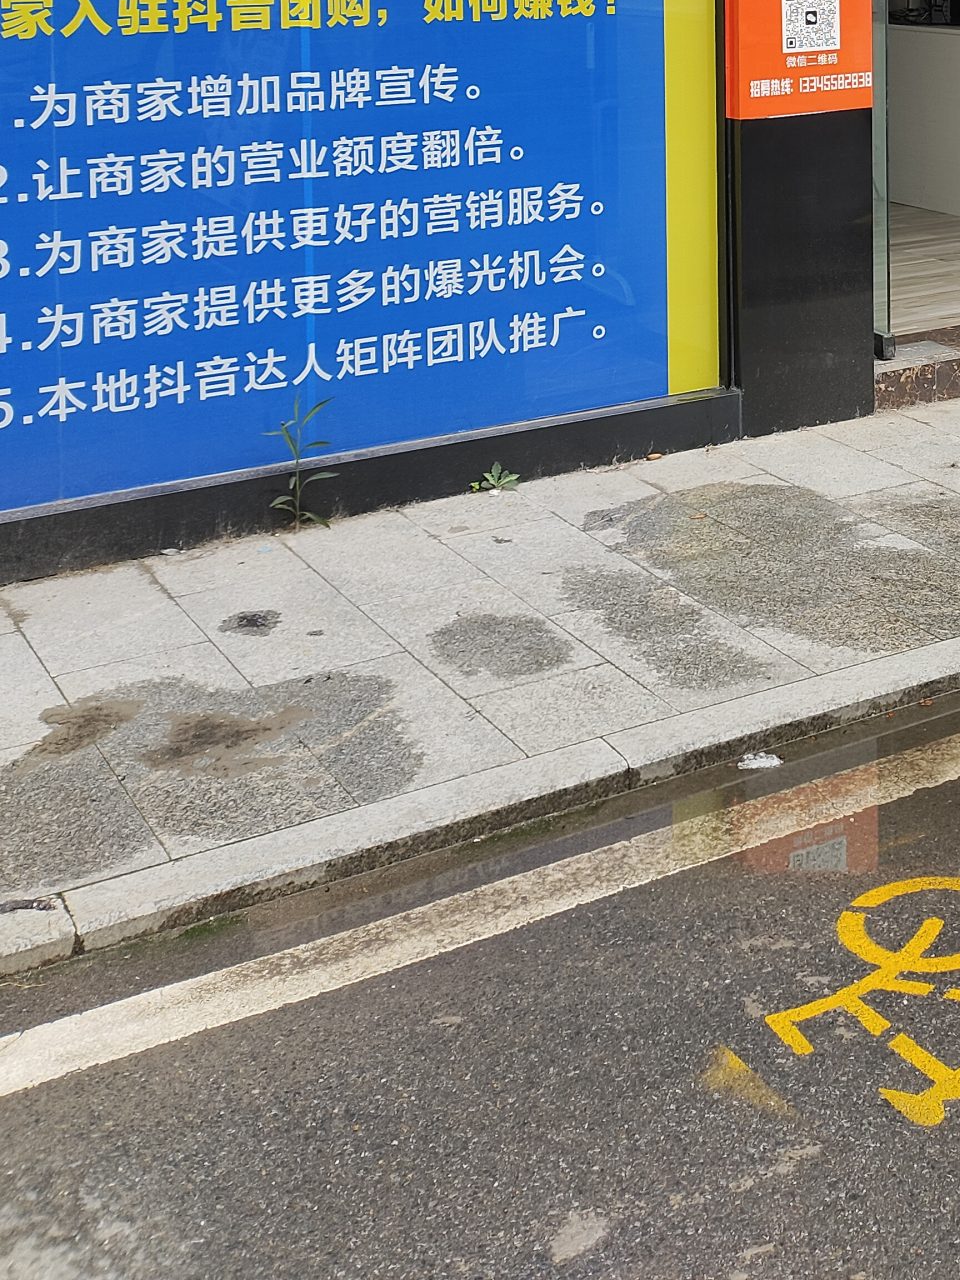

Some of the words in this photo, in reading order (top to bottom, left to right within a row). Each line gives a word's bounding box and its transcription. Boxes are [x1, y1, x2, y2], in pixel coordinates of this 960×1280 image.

[786, 53, 838, 68] 微信二维码
